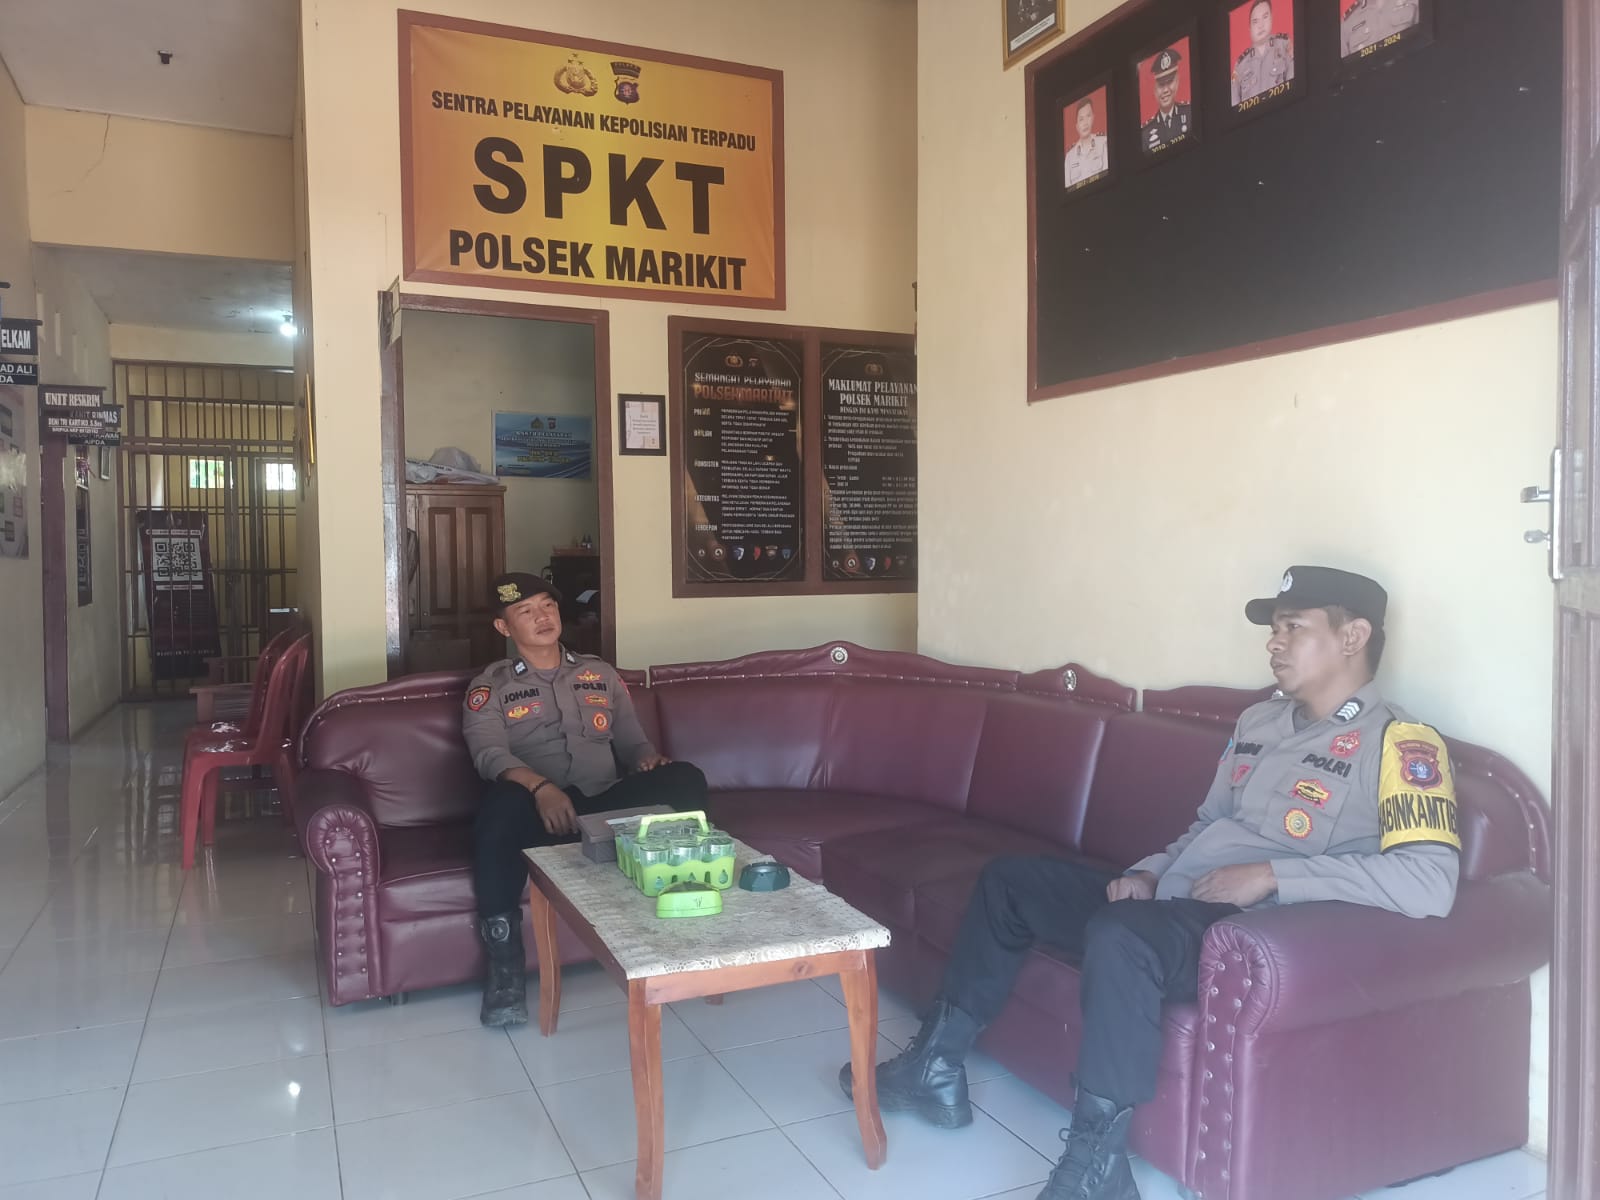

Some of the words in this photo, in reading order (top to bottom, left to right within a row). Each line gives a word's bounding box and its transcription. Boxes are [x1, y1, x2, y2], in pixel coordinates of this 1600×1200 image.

[431, 90, 498, 117] SENTRA
[503, 100, 594, 130] PELAYANAN
[599, 114, 688, 143] KEPOLISIAN
[691, 127, 756, 152] TERPADU
[472, 136, 726, 235] SPKT
[449, 229, 595, 279] POLSEK
[605, 245, 747, 291] MARIKIT
[16, 364, 33, 374] ALI
[828, 378, 872, 393] MAKLUMAT
[45, 392, 68, 406] UNIT
[68, 393, 100, 408] RESKRIM
[840, 393, 872, 406] POLSEK
[873, 394, 909, 408] MARIKIT
[573, 682, 607, 692] POLRI
[503, 687, 541, 704] JOHARI
[1302, 753, 1353, 778] POLRI
